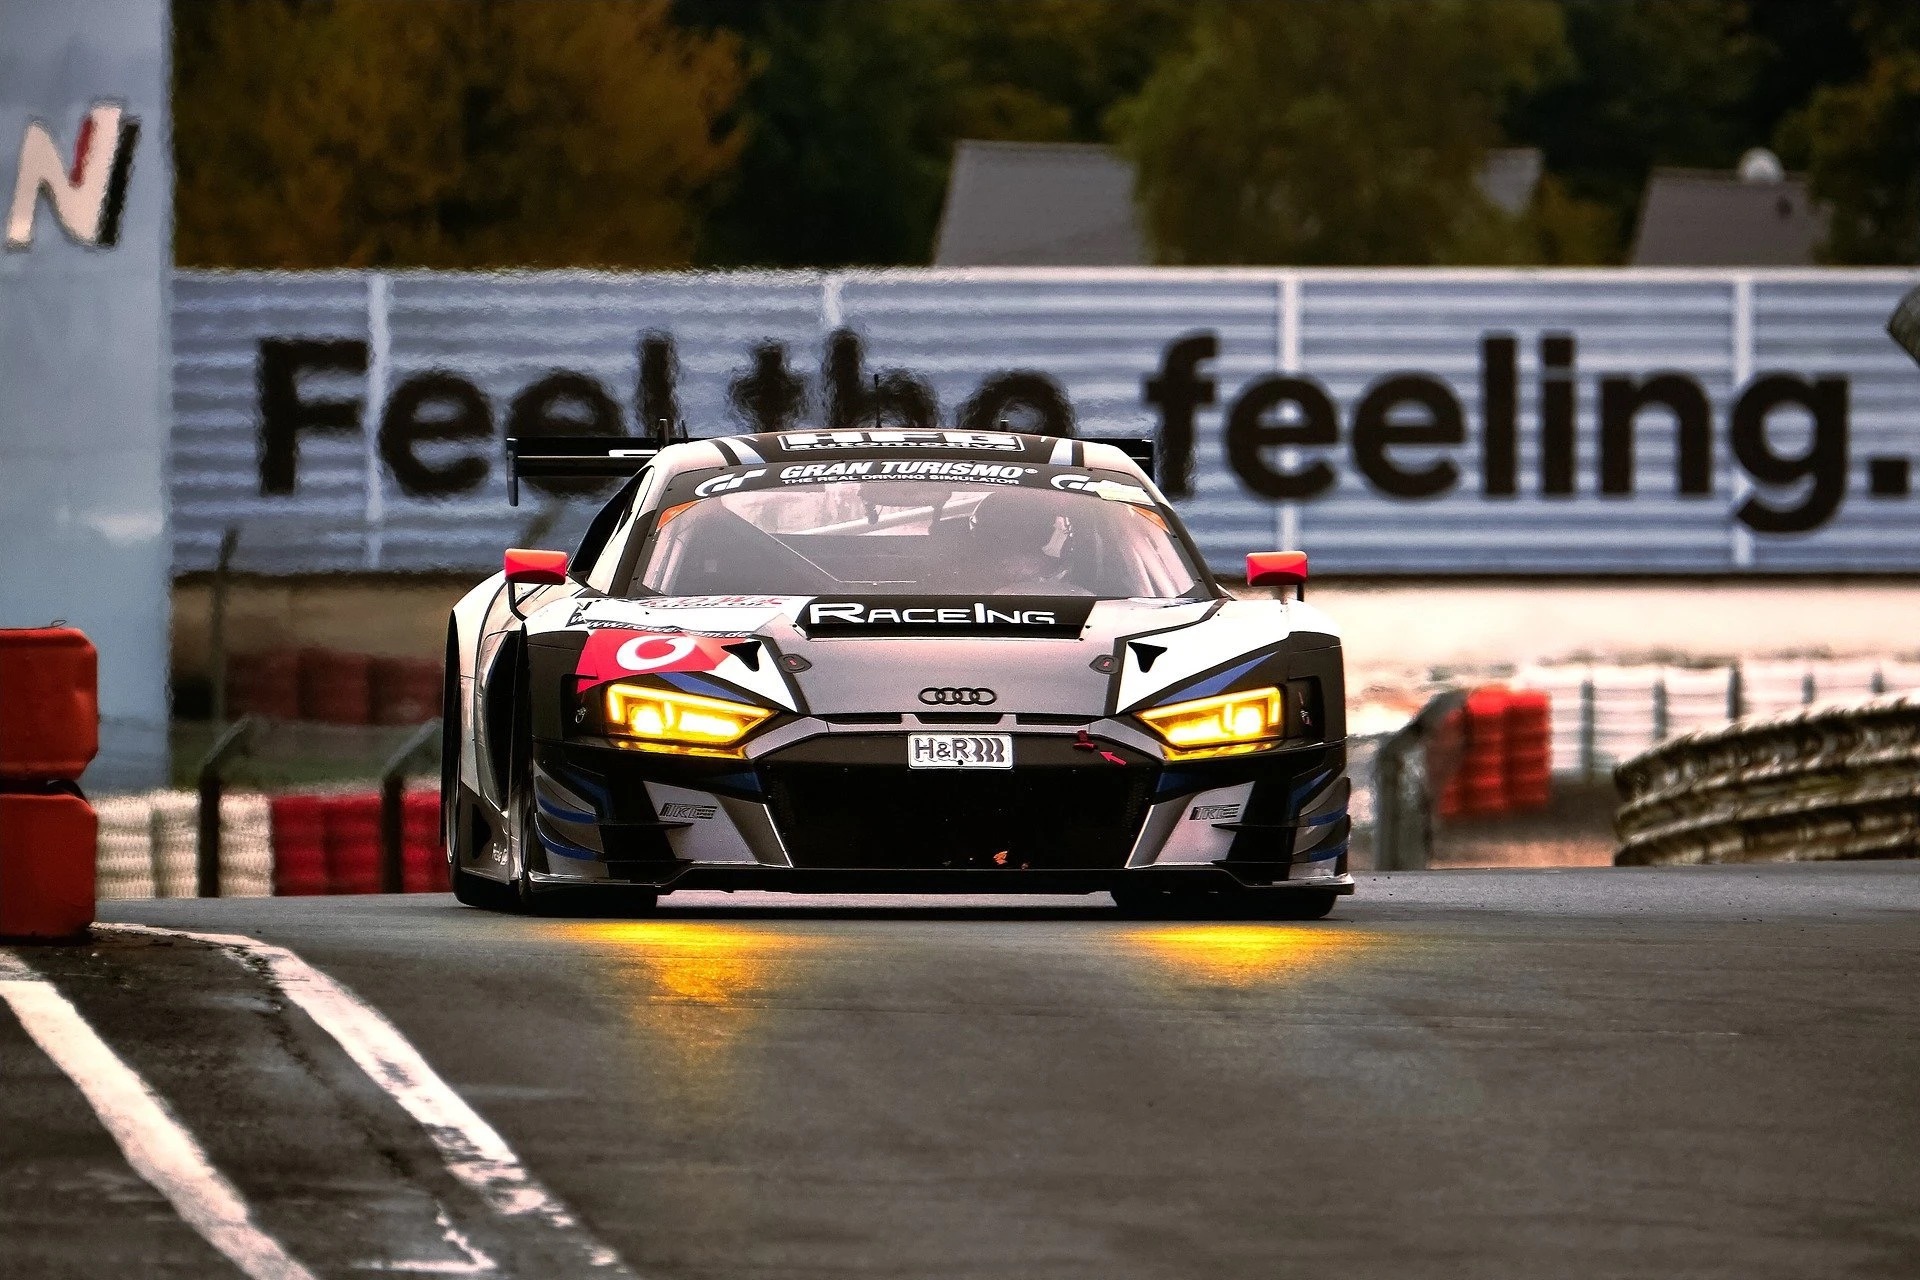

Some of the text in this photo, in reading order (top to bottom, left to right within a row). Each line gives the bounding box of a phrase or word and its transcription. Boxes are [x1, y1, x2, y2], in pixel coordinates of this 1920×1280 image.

[257, 328, 677, 496] Feel
[1146, 329, 1909, 533] feeling.
[780, 460, 874, 480] GRAN
[782, 473, 1020, 485] THE REAL DRIVING SIMULATOR
[914, 737, 972, 763] H&R
